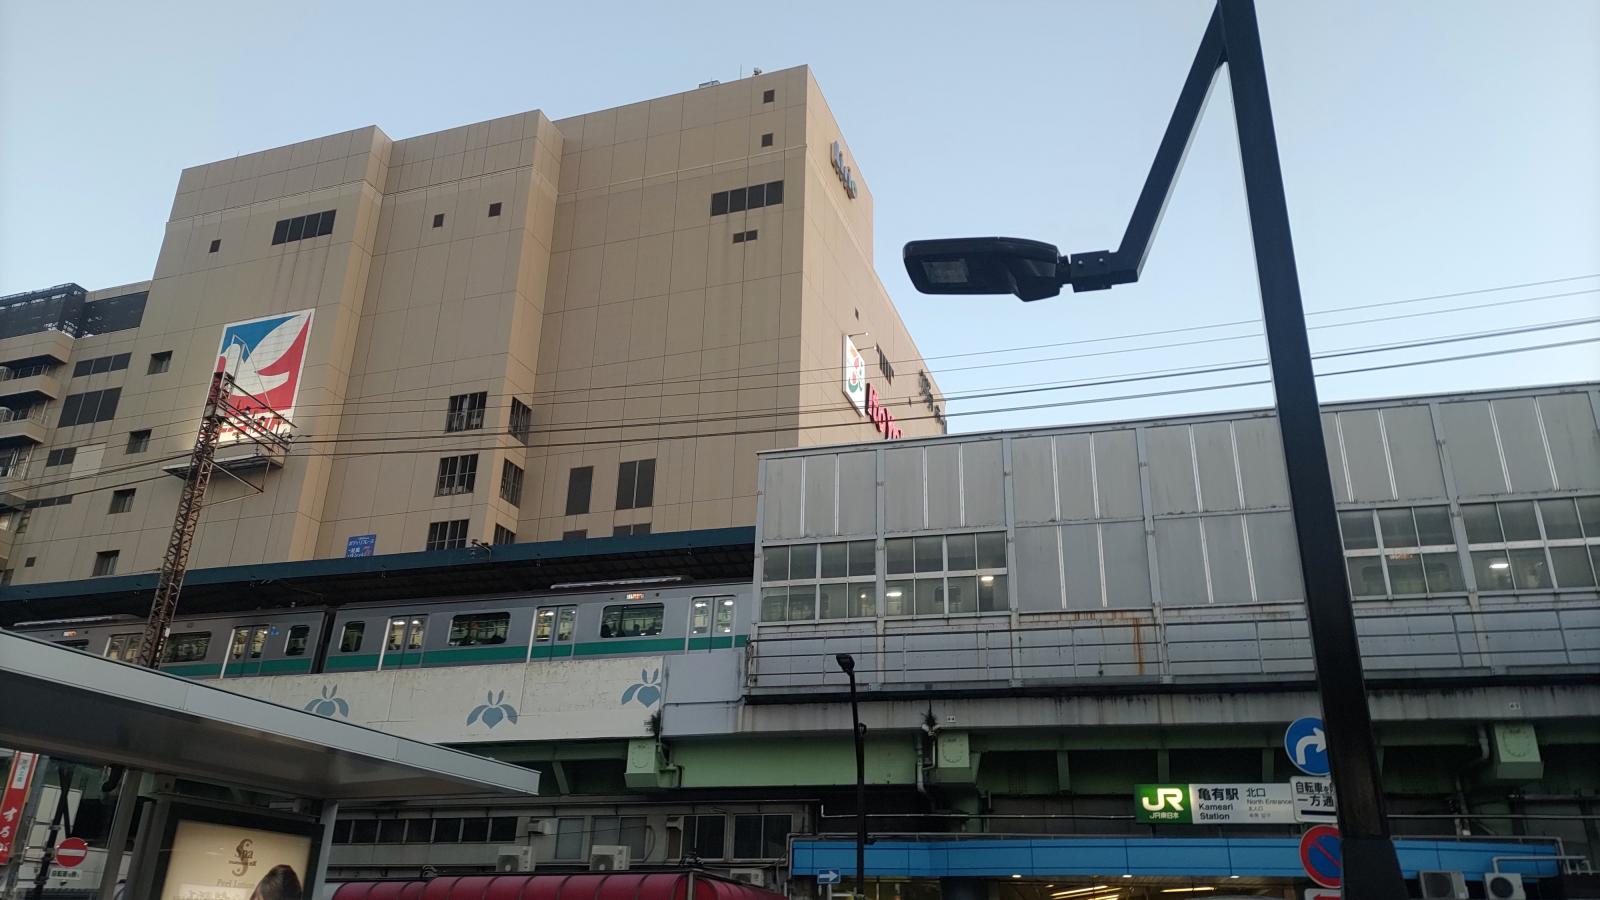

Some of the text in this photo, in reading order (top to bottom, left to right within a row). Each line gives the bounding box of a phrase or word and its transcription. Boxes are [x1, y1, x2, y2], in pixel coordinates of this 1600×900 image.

[1198, 787, 1239, 801] 亀有駅
[1246, 787, 1266, 798] 北口
[1142, 787, 1184, 811] JR
[1198, 803, 1234, 811] Kameari
[1199, 812, 1230, 821] Station
